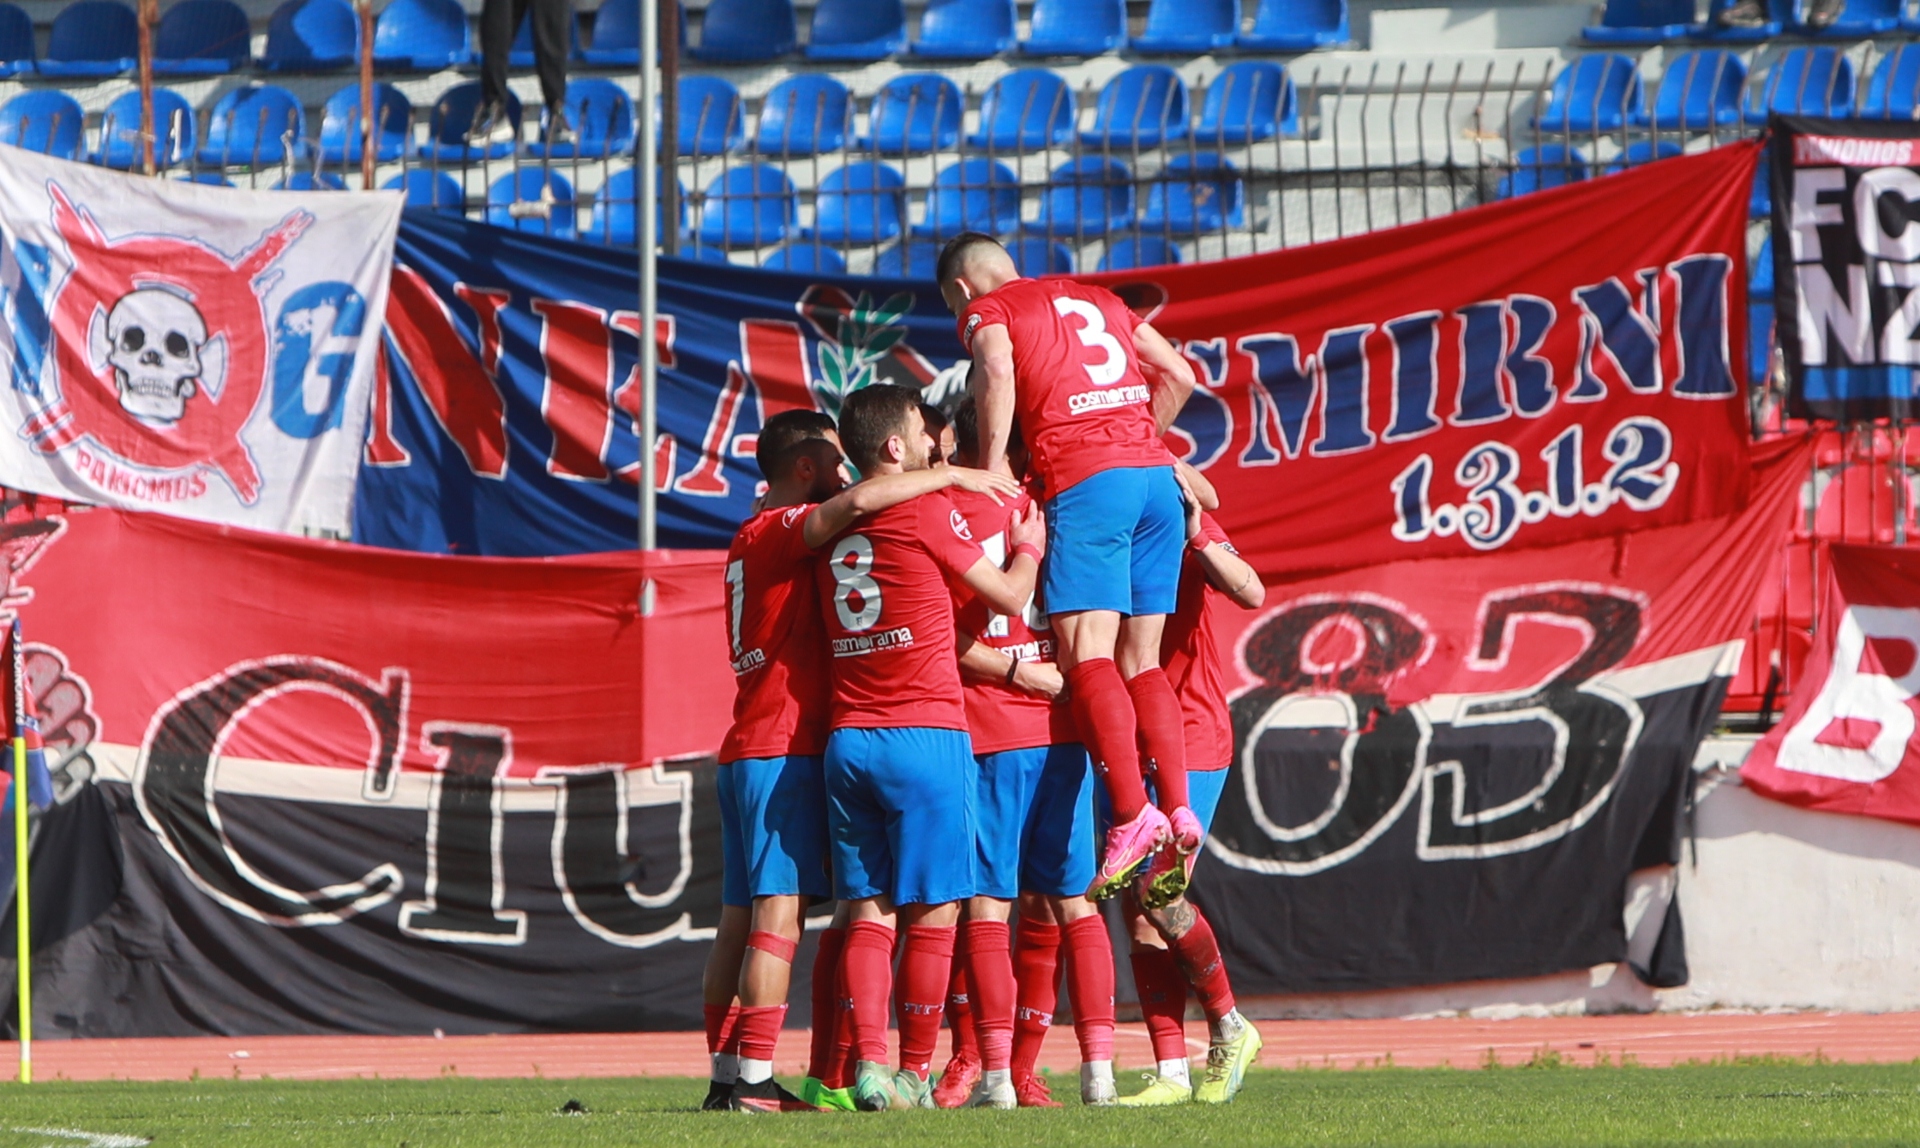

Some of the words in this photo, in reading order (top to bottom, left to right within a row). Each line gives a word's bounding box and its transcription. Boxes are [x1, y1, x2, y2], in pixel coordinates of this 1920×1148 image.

[1794, 133, 1913, 165] PANIONIOS
[1789, 166, 1920, 261] FC
[269, 280, 366, 440] G
[367, 263, 821, 499] NEA
[1165, 252, 1738, 472] SMIRNI
[1051, 295, 1128, 387] 3
[1068, 384, 1151, 411] cosmorama
[1391, 416, 1679, 550] 1.3.1.2
[726, 559, 744, 656] 1
[829, 533, 882, 632] 8
[832, 627, 914, 653] cosmorama
[1774, 604, 1920, 784] B
[133, 655, 722, 949] Clu
[1207, 580, 1651, 877] 83
